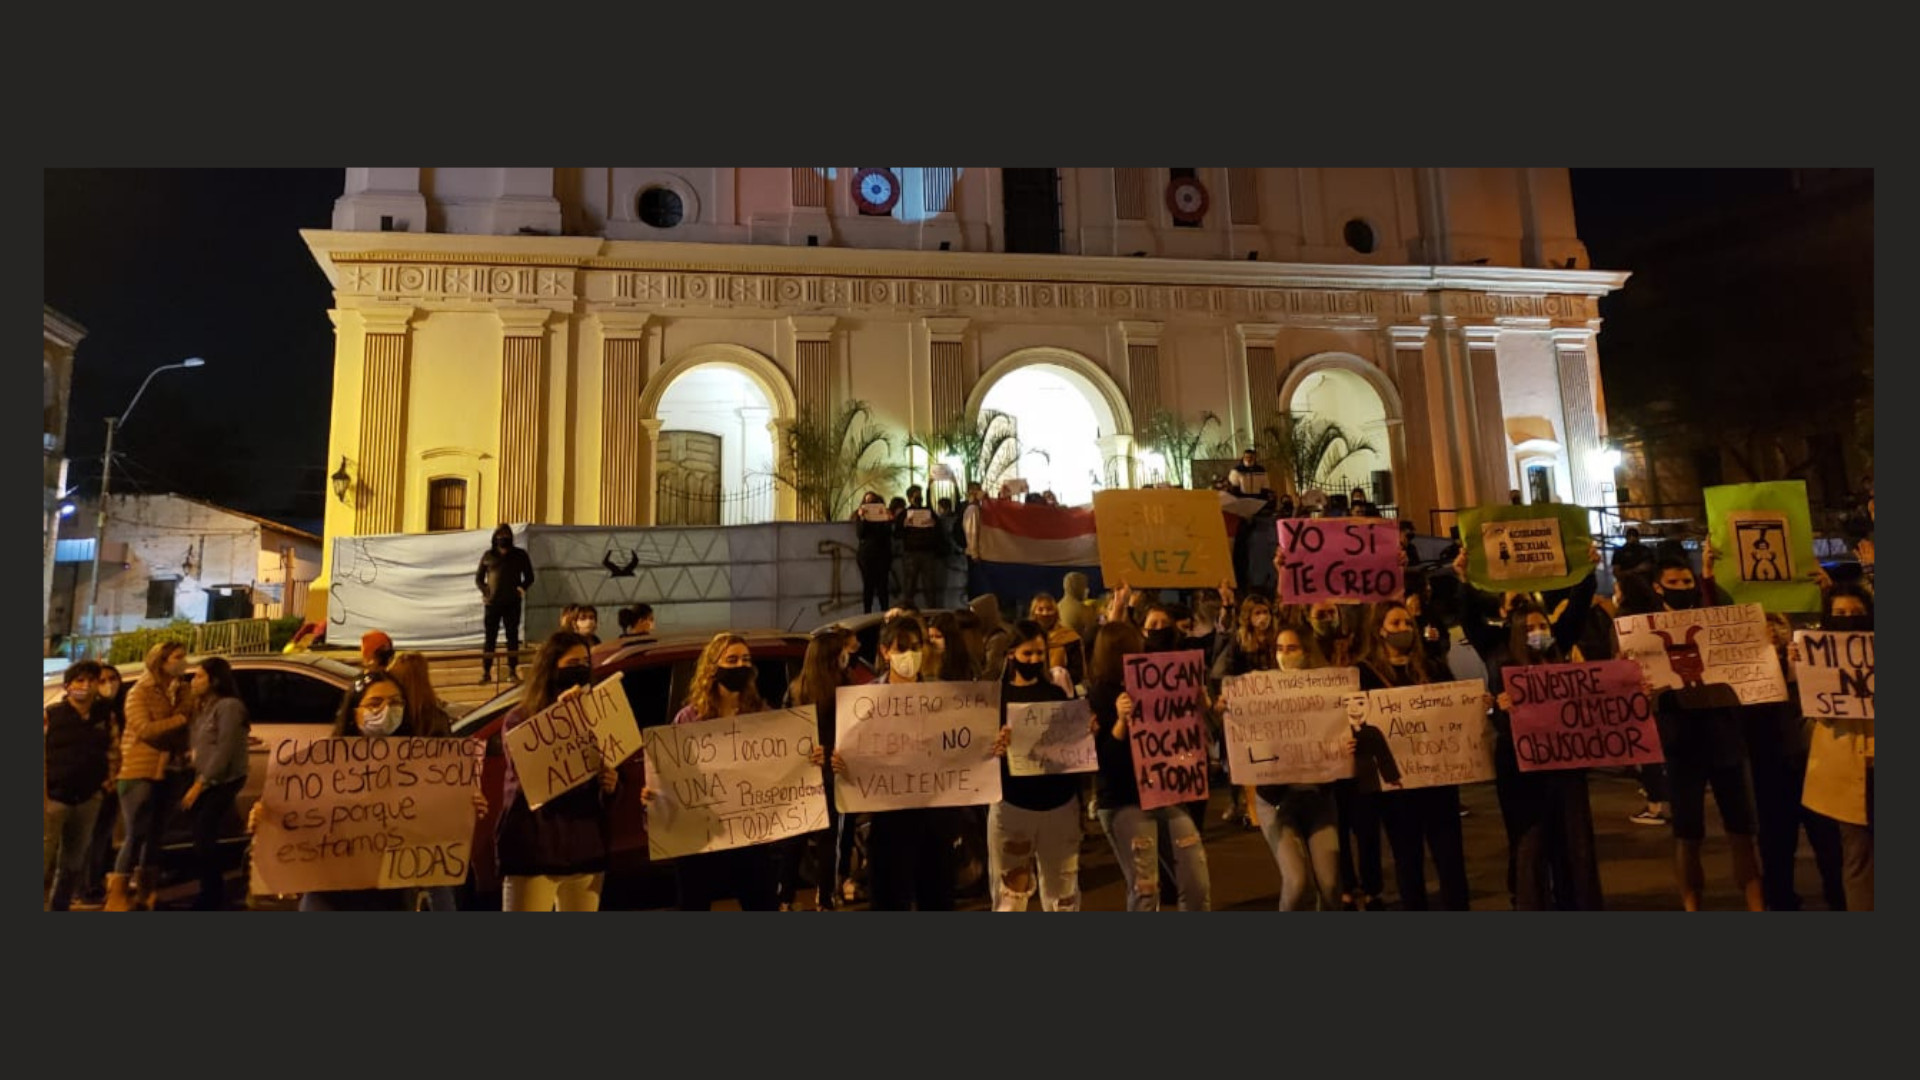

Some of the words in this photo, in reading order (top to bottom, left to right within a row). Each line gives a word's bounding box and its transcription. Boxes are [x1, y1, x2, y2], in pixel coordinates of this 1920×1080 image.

[1282, 521, 1325, 554] YO
[1513, 541, 1552, 551] SEXUAL
[1130, 550, 1197, 575] VEZ
[1515, 551, 1555, 563] SUELTO
[1284, 563, 1316, 596] TE
[1325, 560, 1397, 596] CREO
[1803, 634, 1839, 668] MI
[1127, 658, 1206, 691] TOCAN
[523, 686, 619, 753] JUSTICIA
[853, 696, 943, 722] QUIERO
[1132, 700, 1144, 724] A
[1154, 696, 1199, 722] UNA
[1561, 692, 1651, 729] OLMEDO
[1816, 691, 1849, 715] SE
[1855, 692, 1874, 717] T
[552, 729, 598, 762] PARA
[943, 726, 971, 750] NO
[1133, 725, 1201, 758] TOCAN
[547, 732, 626, 795] ALEXA
[1140, 765, 1153, 789] A
[1151, 760, 1206, 796] TODAS
[673, 772, 728, 809] UNA
[329, 796, 417, 834] porque
[276, 828, 405, 864] estamos
[386, 842, 466, 880] TODAS
